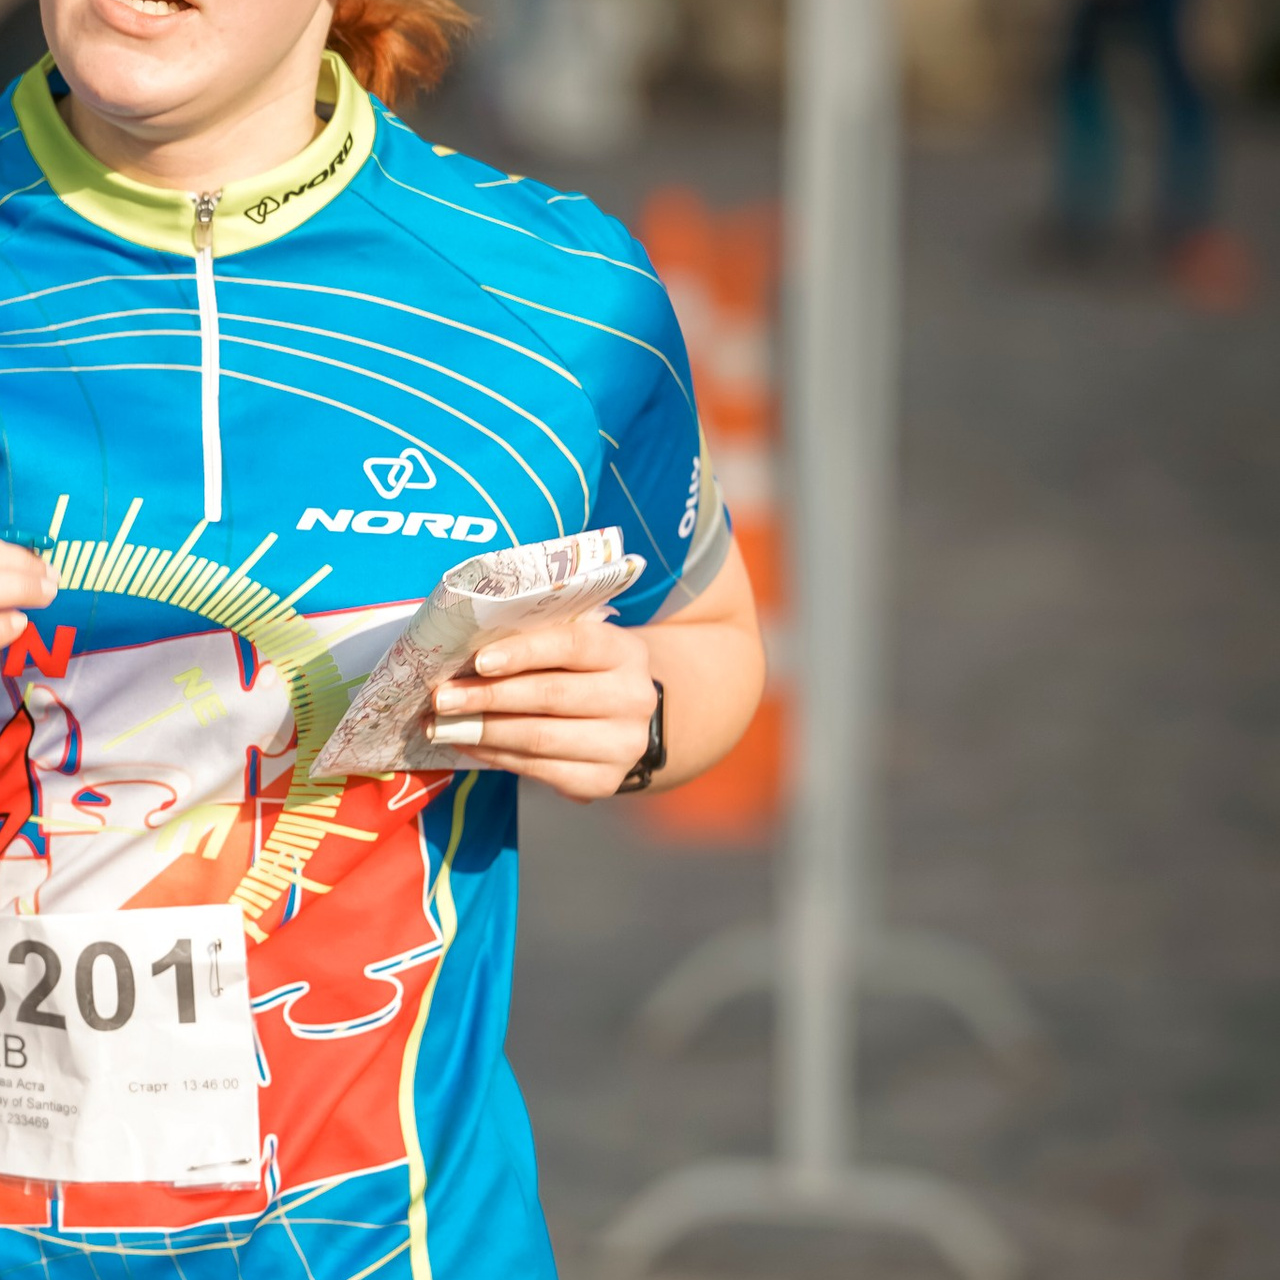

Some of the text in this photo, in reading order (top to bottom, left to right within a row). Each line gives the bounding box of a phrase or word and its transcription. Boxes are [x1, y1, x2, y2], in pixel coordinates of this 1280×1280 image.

[282, 131, 353, 205] NORD
[295, 507, 498, 543] NORD
[3, 620, 77, 678] N
[173, 666, 228, 728] NE
[12, 1095, 23, 1108] of
